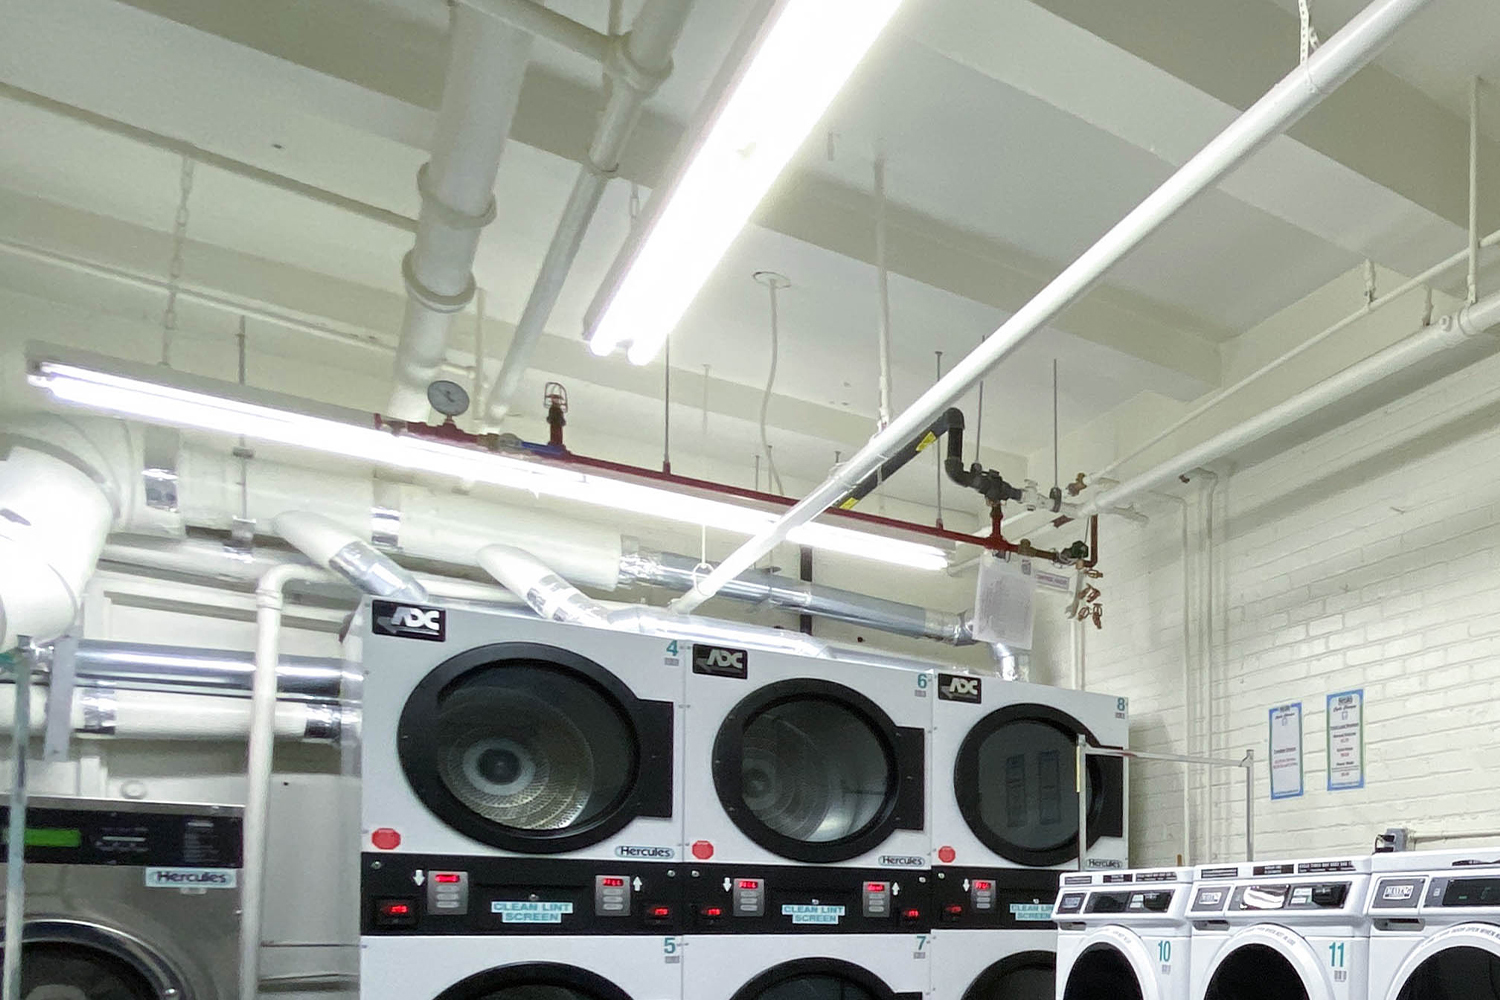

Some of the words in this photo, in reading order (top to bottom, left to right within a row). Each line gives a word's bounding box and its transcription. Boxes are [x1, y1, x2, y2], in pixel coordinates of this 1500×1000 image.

[391, 606, 440, 628] ADC
[666, 640, 679, 656] 4
[707, 649, 743, 668] ADC
[917, 673, 928, 688] 6
[949, 677, 978, 695] ADC
[1116, 697, 1126, 711] 8
[620, 845, 671, 858] Hercules
[882, 855, 922, 867] Hercules
[157, 870, 227, 884] Hercules
[493, 902, 536, 912] CLEAN
[538, 902, 571, 912] LINT
[783, 905, 818, 914] CLEAN
[820, 906, 844, 915] LINT
[505, 912, 559, 922] SCREEN
[794, 914, 837, 923] SCREEN
[664, 937, 676, 954] 5
[916, 935, 927, 950] 7
[1158, 940, 1171, 962] 10
[1328, 942, 1345, 967] 11
